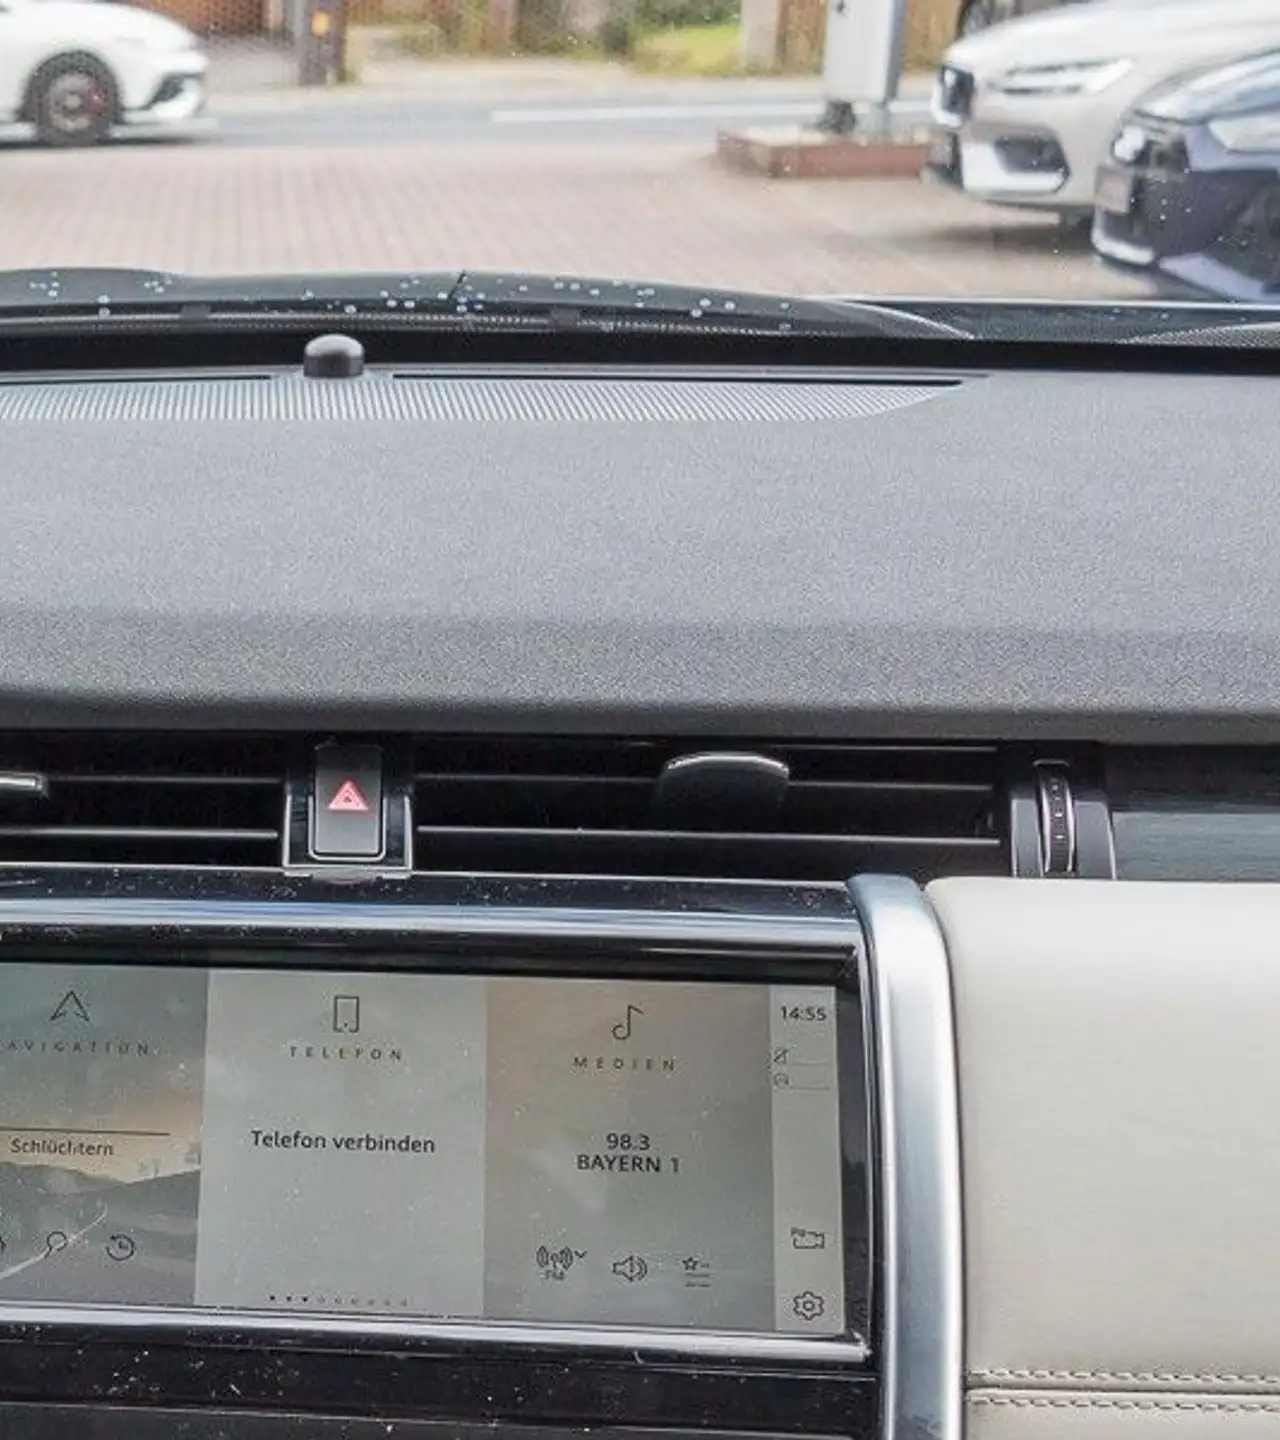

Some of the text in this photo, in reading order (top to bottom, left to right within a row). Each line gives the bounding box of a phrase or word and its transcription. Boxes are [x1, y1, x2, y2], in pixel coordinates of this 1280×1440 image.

[780, 1005, 828, 1022] 14:55
[290, 1046, 403, 1061] TELEFON
[573, 1057, 677, 1072] MEDIEN
[9, 1137, 115, 1157] Schlüchtern
[251, 1130, 436, 1153] Telefon verbinden
[605, 1133, 651, 1152] 98.3
[576, 1154, 680, 1173] BAYERN 1
